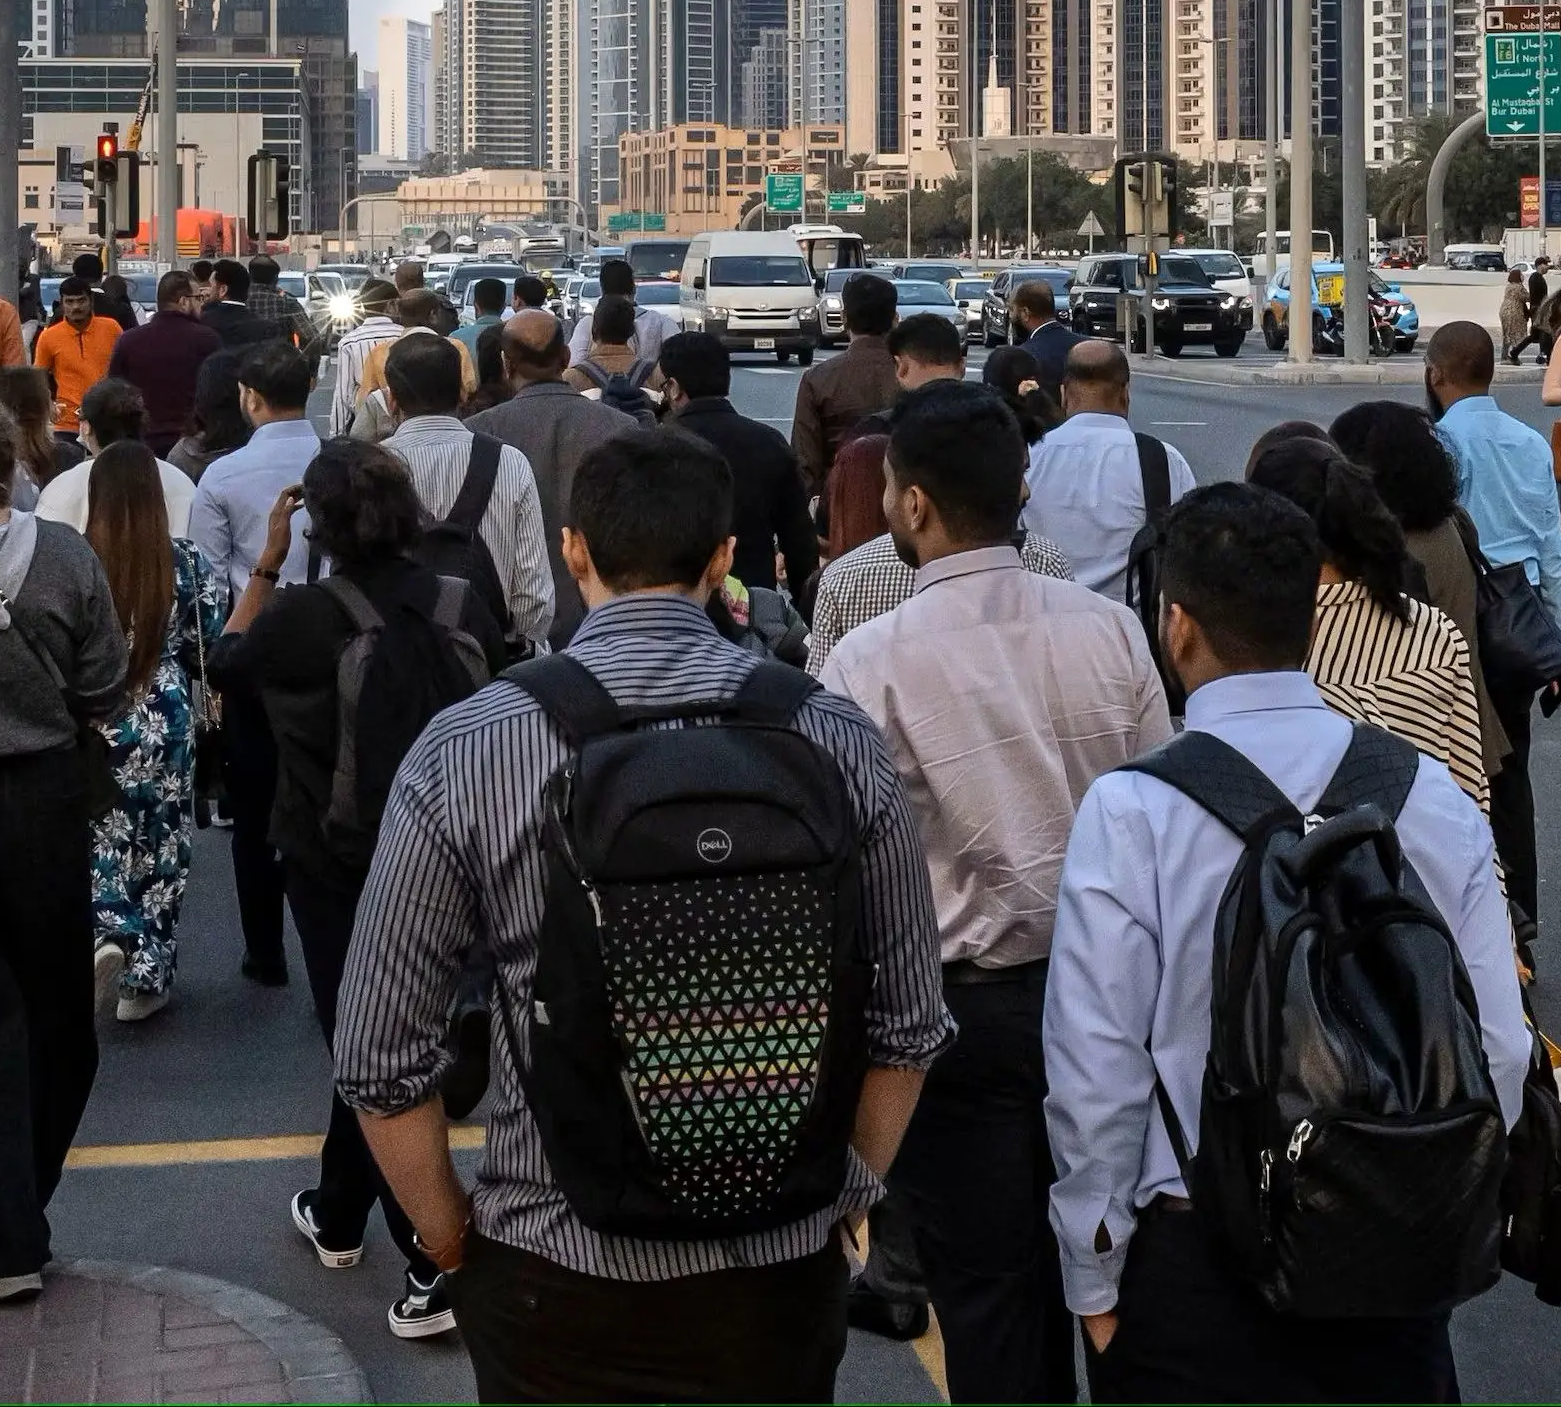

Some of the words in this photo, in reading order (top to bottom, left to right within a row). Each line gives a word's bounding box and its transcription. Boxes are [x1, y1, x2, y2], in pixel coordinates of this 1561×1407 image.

[1505, 22, 1518, 30] The
[1520, 22, 1540, 30] Duba
[1491, 68, 1531, 79] المستقبل
[1491, 99, 1500, 107] Al
[1502, 98, 1540, 107] Mustaqba
[1545, 98, 1554, 106] St
[1491, 107, 1506, 116] Bur
[1510, 107, 1535, 115] Dubai
[701, 840, 728, 851] DELL
